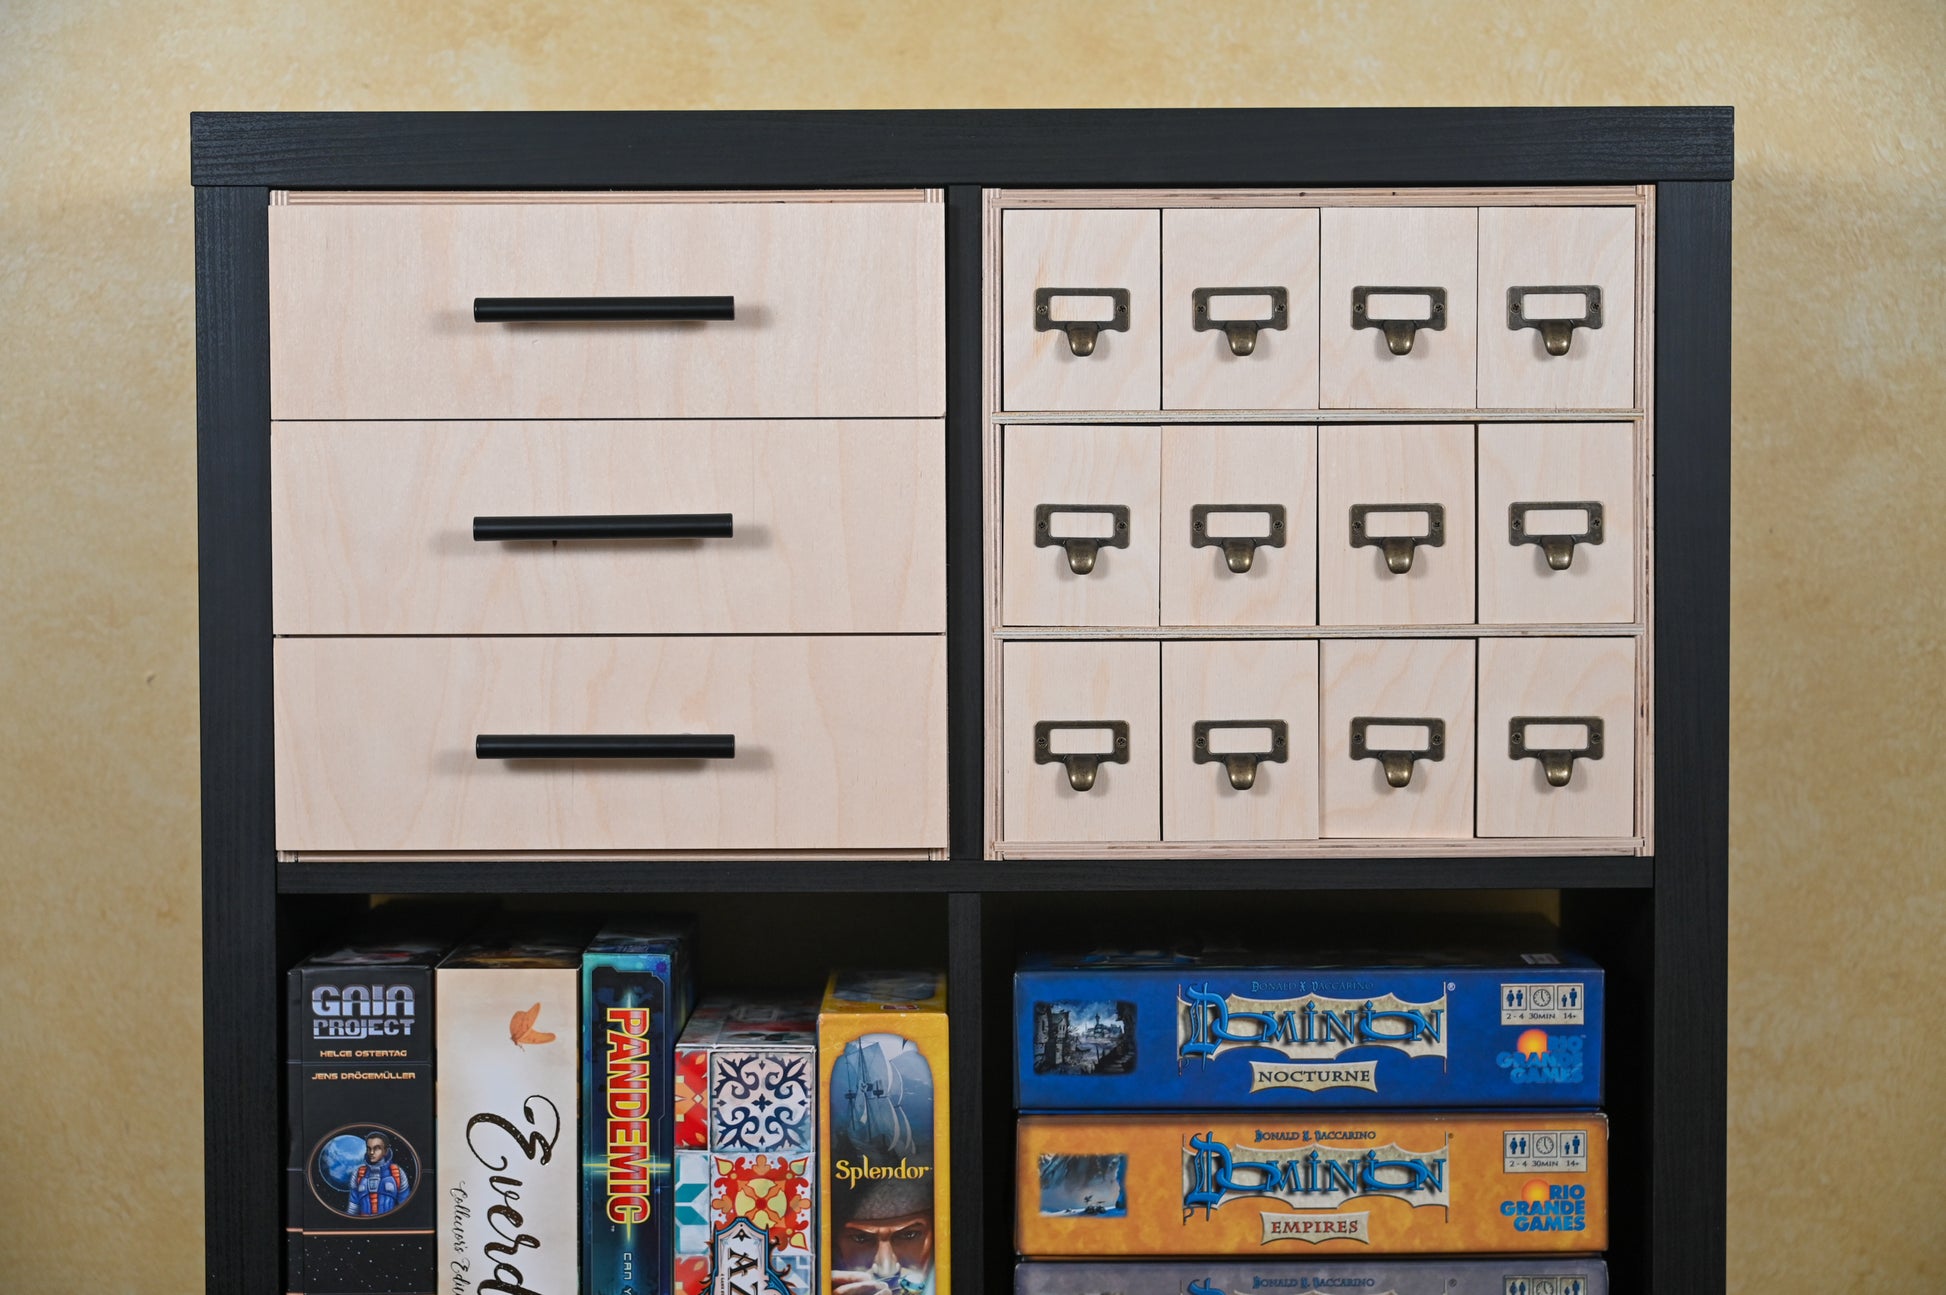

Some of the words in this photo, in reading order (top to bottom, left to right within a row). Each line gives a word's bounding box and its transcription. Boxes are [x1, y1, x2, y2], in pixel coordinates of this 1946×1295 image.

[311, 984, 415, 1016] GAIA
[313, 1019, 415, 1039] PROJECT
[1182, 982, 1445, 1071] DOMINION
[1547, 1035, 1584, 1052] RIO
[320, 1050, 352, 1058] HELGE
[355, 1050, 407, 1058] OSTERTAG
[1496, 1051, 1584, 1068] GRANDE
[312, 1072, 338, 1080] JENS
[341, 1070, 416, 1080] DRÖGEMÜLLER
[1258, 1069, 1371, 1083] NOCTURNE
[1510, 1067, 1584, 1084] GAMES
[606, 1007, 651, 1225] PANDEMIC
[1254, 1129, 1300, 1142] DONALD
[1315, 1130, 1377, 1142] VACCARINO
[835, 1154, 930, 1190] Splendor
[1184, 1131, 1447, 1221] DOMINION
[1549, 1184, 1586, 1200] RIO
[1500, 1200, 1586, 1216] GRANDE
[450, 1180, 472, 1254] Collector's
[1513, 1215, 1586, 1232] GAMES
[1271, 1221, 1359, 1233] EMPIRES
